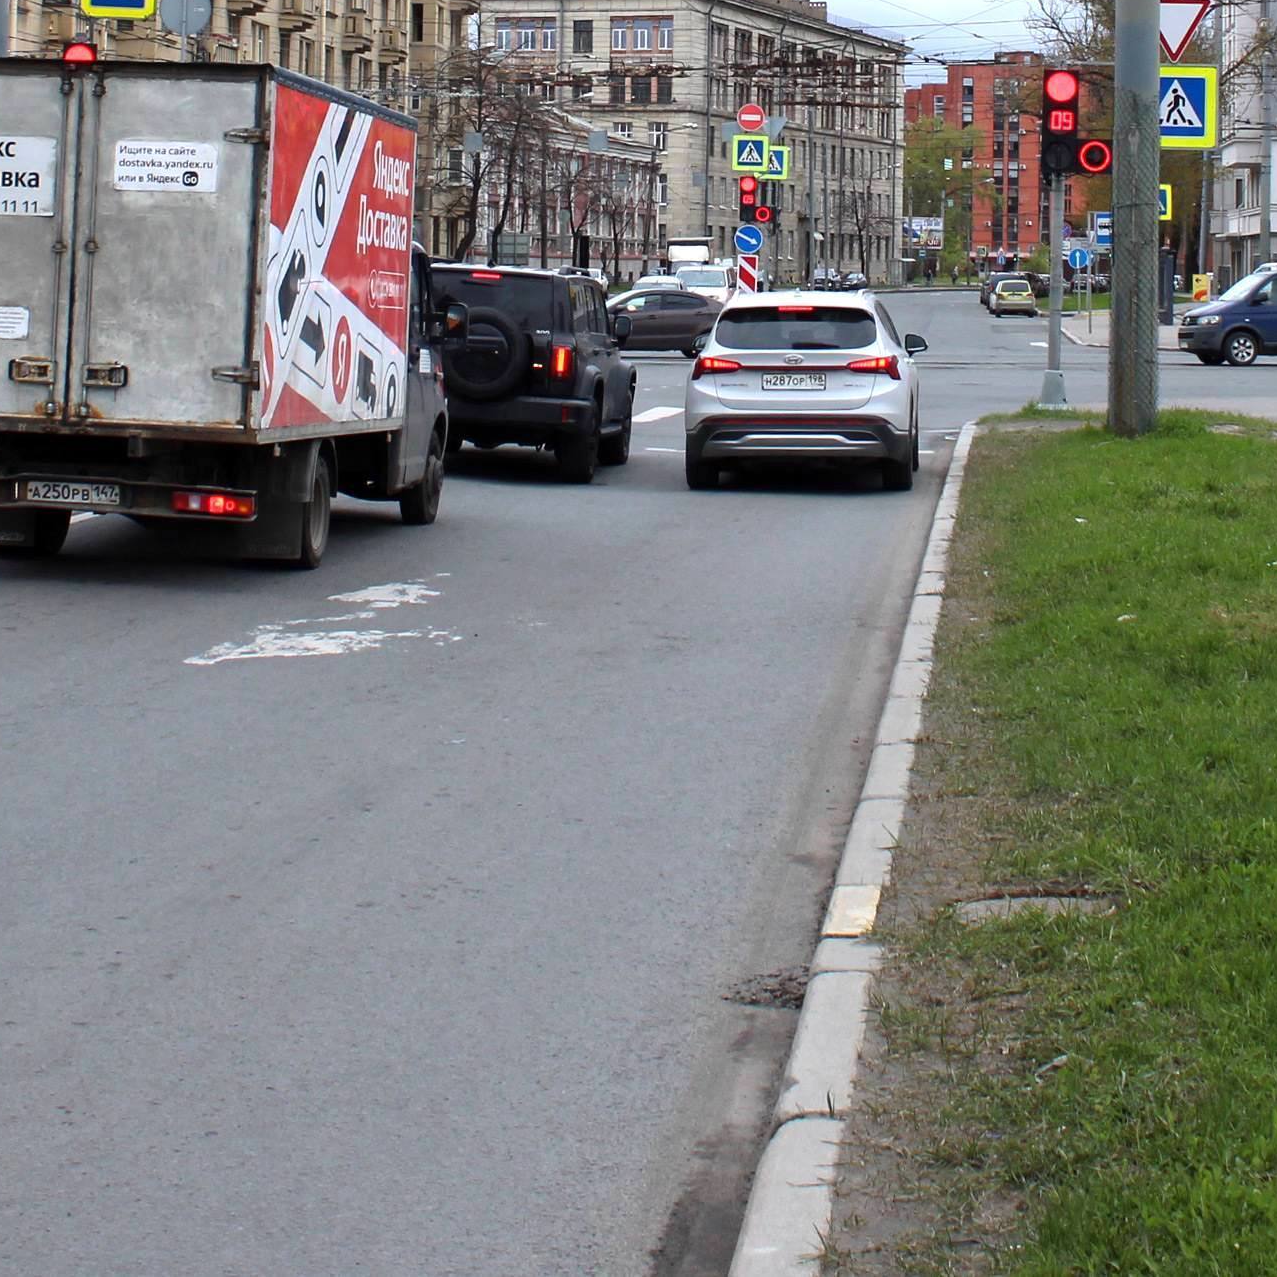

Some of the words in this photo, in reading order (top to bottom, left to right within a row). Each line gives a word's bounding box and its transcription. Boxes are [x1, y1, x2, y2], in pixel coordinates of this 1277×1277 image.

[1050, 111, 1073, 131] 09
[119, 145, 153, 155] Ищите
[155, 147, 167, 155] на
[168, 147, 197, 155] сайте
[118, 158, 213, 169] dostavka.yandex.ru
[372, 140, 410, 200] Яндекс
[118, 175, 136, 183] или
[146, 173, 180, 184] Яндекс
[183, 173, 197, 185] Go
[1, 200, 17, 213] 11
[22, 200, 39, 214] 11
[356, 194, 408, 254] Доставка
[32, 484, 90, 501] А250РВ
[94, 486, 114, 498] 147
